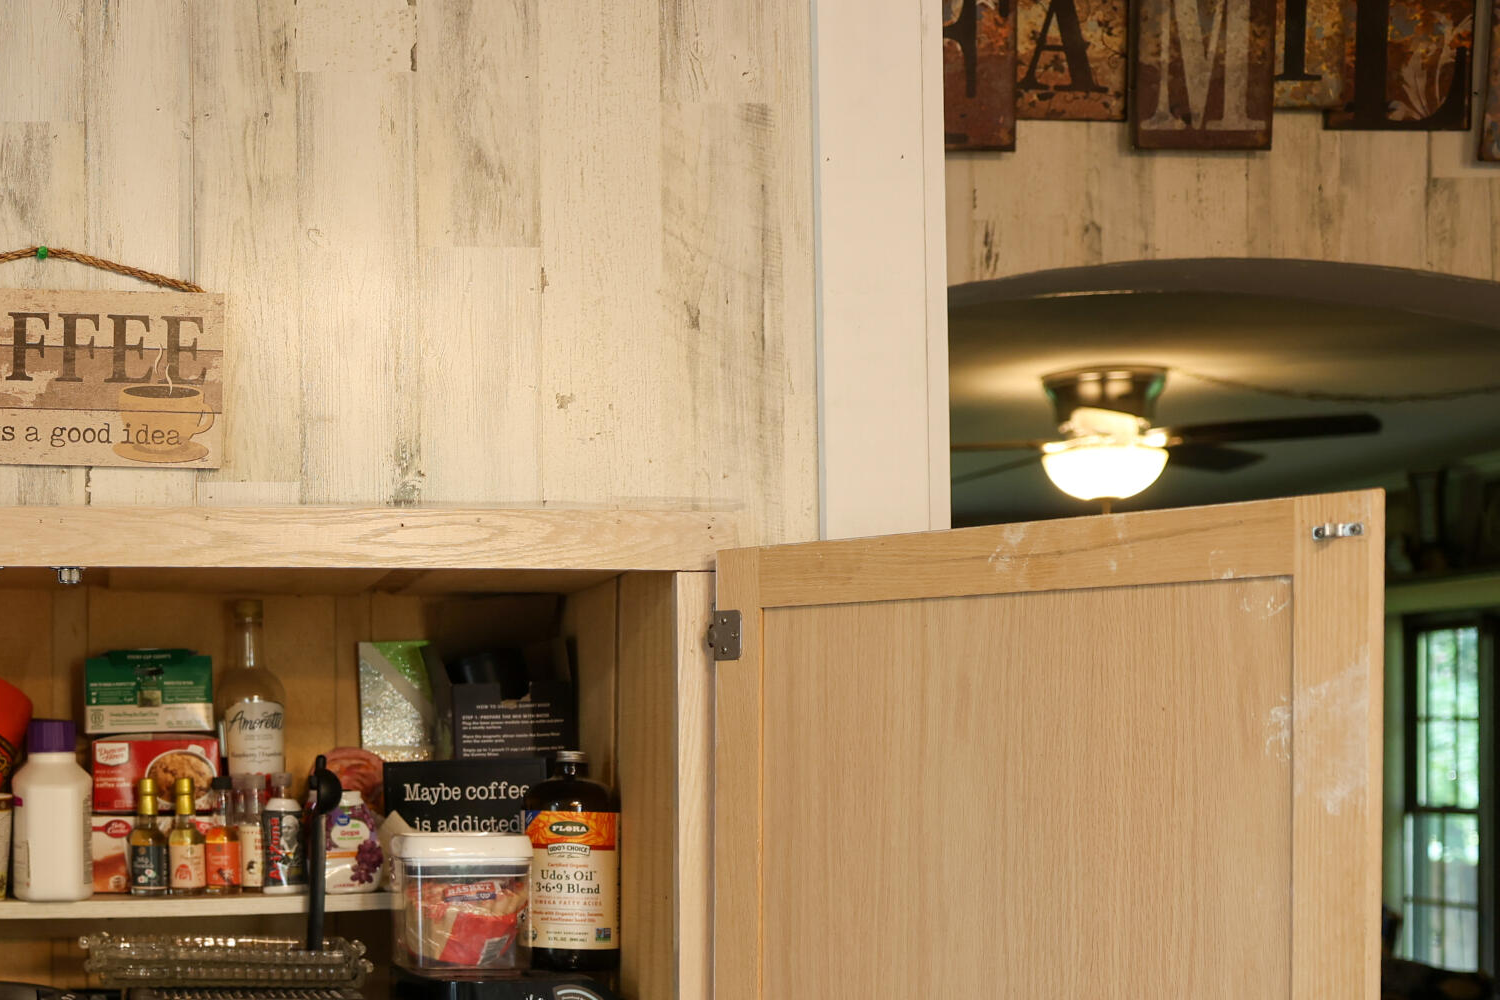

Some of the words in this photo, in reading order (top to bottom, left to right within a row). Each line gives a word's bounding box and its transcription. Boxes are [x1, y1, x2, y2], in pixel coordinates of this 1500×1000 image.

[25, 425, 41, 442] a
[50, 423, 113, 447] good
[122, 423, 182, 446] idea
[403, 783, 462, 805] Maybe
[465, 781, 529, 801] coffee
[414, 817, 431, 833] is
[438, 814, 521, 833] addicted
[551, 825, 587, 833] FLORA
[567, 845, 588, 853] CHOICE
[540, 869, 570, 881] Udo's
[567, 883, 600, 894] Blend
